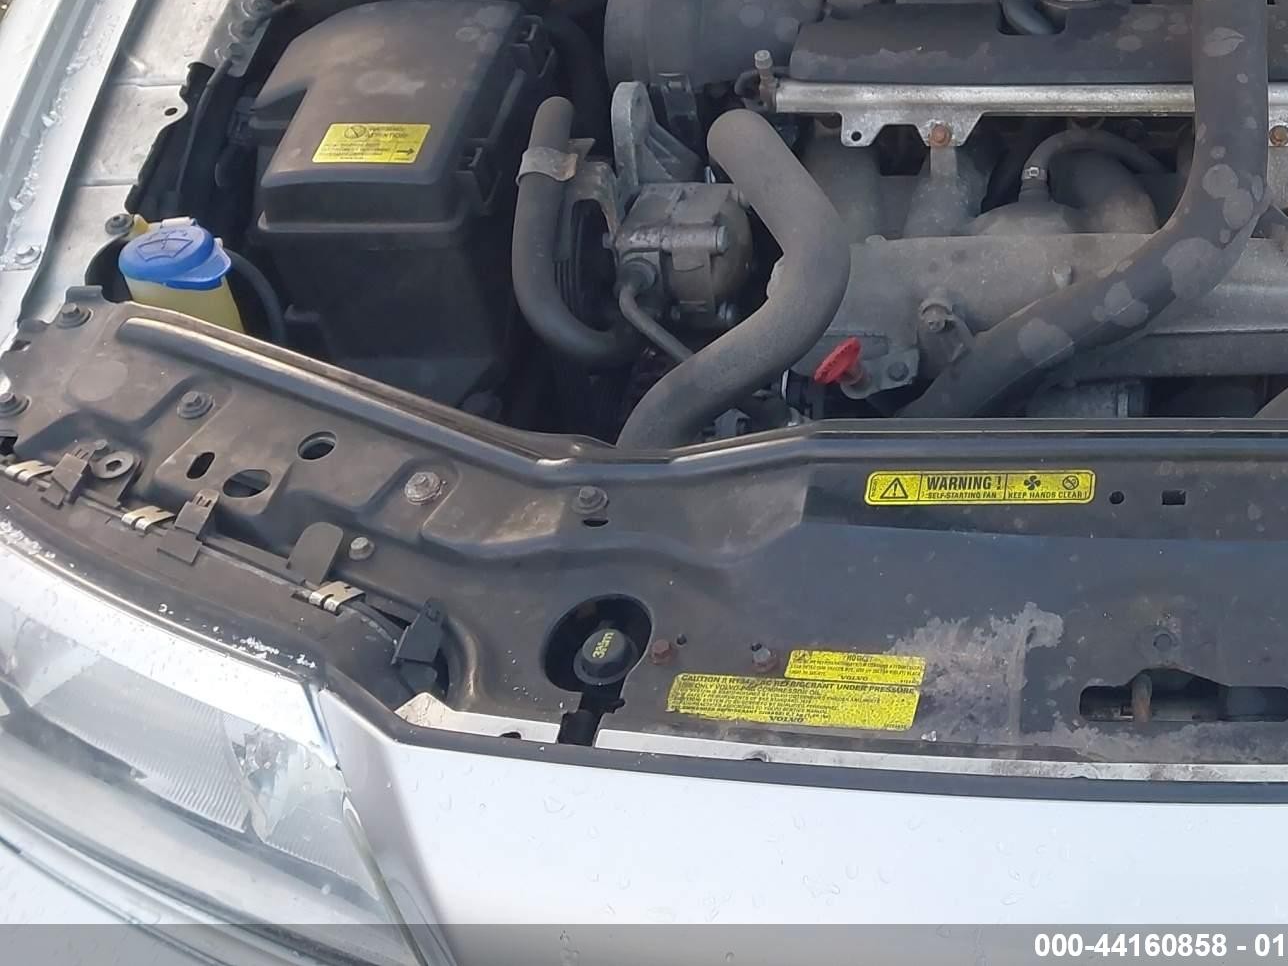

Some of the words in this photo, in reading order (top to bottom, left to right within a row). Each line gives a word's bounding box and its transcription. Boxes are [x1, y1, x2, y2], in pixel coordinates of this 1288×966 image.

[927, 475, 992, 491] WARNING
[927, 492, 981, 500] SELF-STARTING
[1008, 491, 1027, 499] KEEP
[1029, 491, 1057, 499] HANDS
[1058, 491, 1082, 499] CLEAR
[681, 674, 720, 683] CAUTION
[775, 680, 835, 690] REFRIGERANT
[837, 683, 868, 692] UNDER
[868, 686, 915, 695] PRESSURE
[695, 682, 714, 690] ONLY
[715, 683, 740, 691] VOLVO
[768, 715, 805, 723] VOLVO
